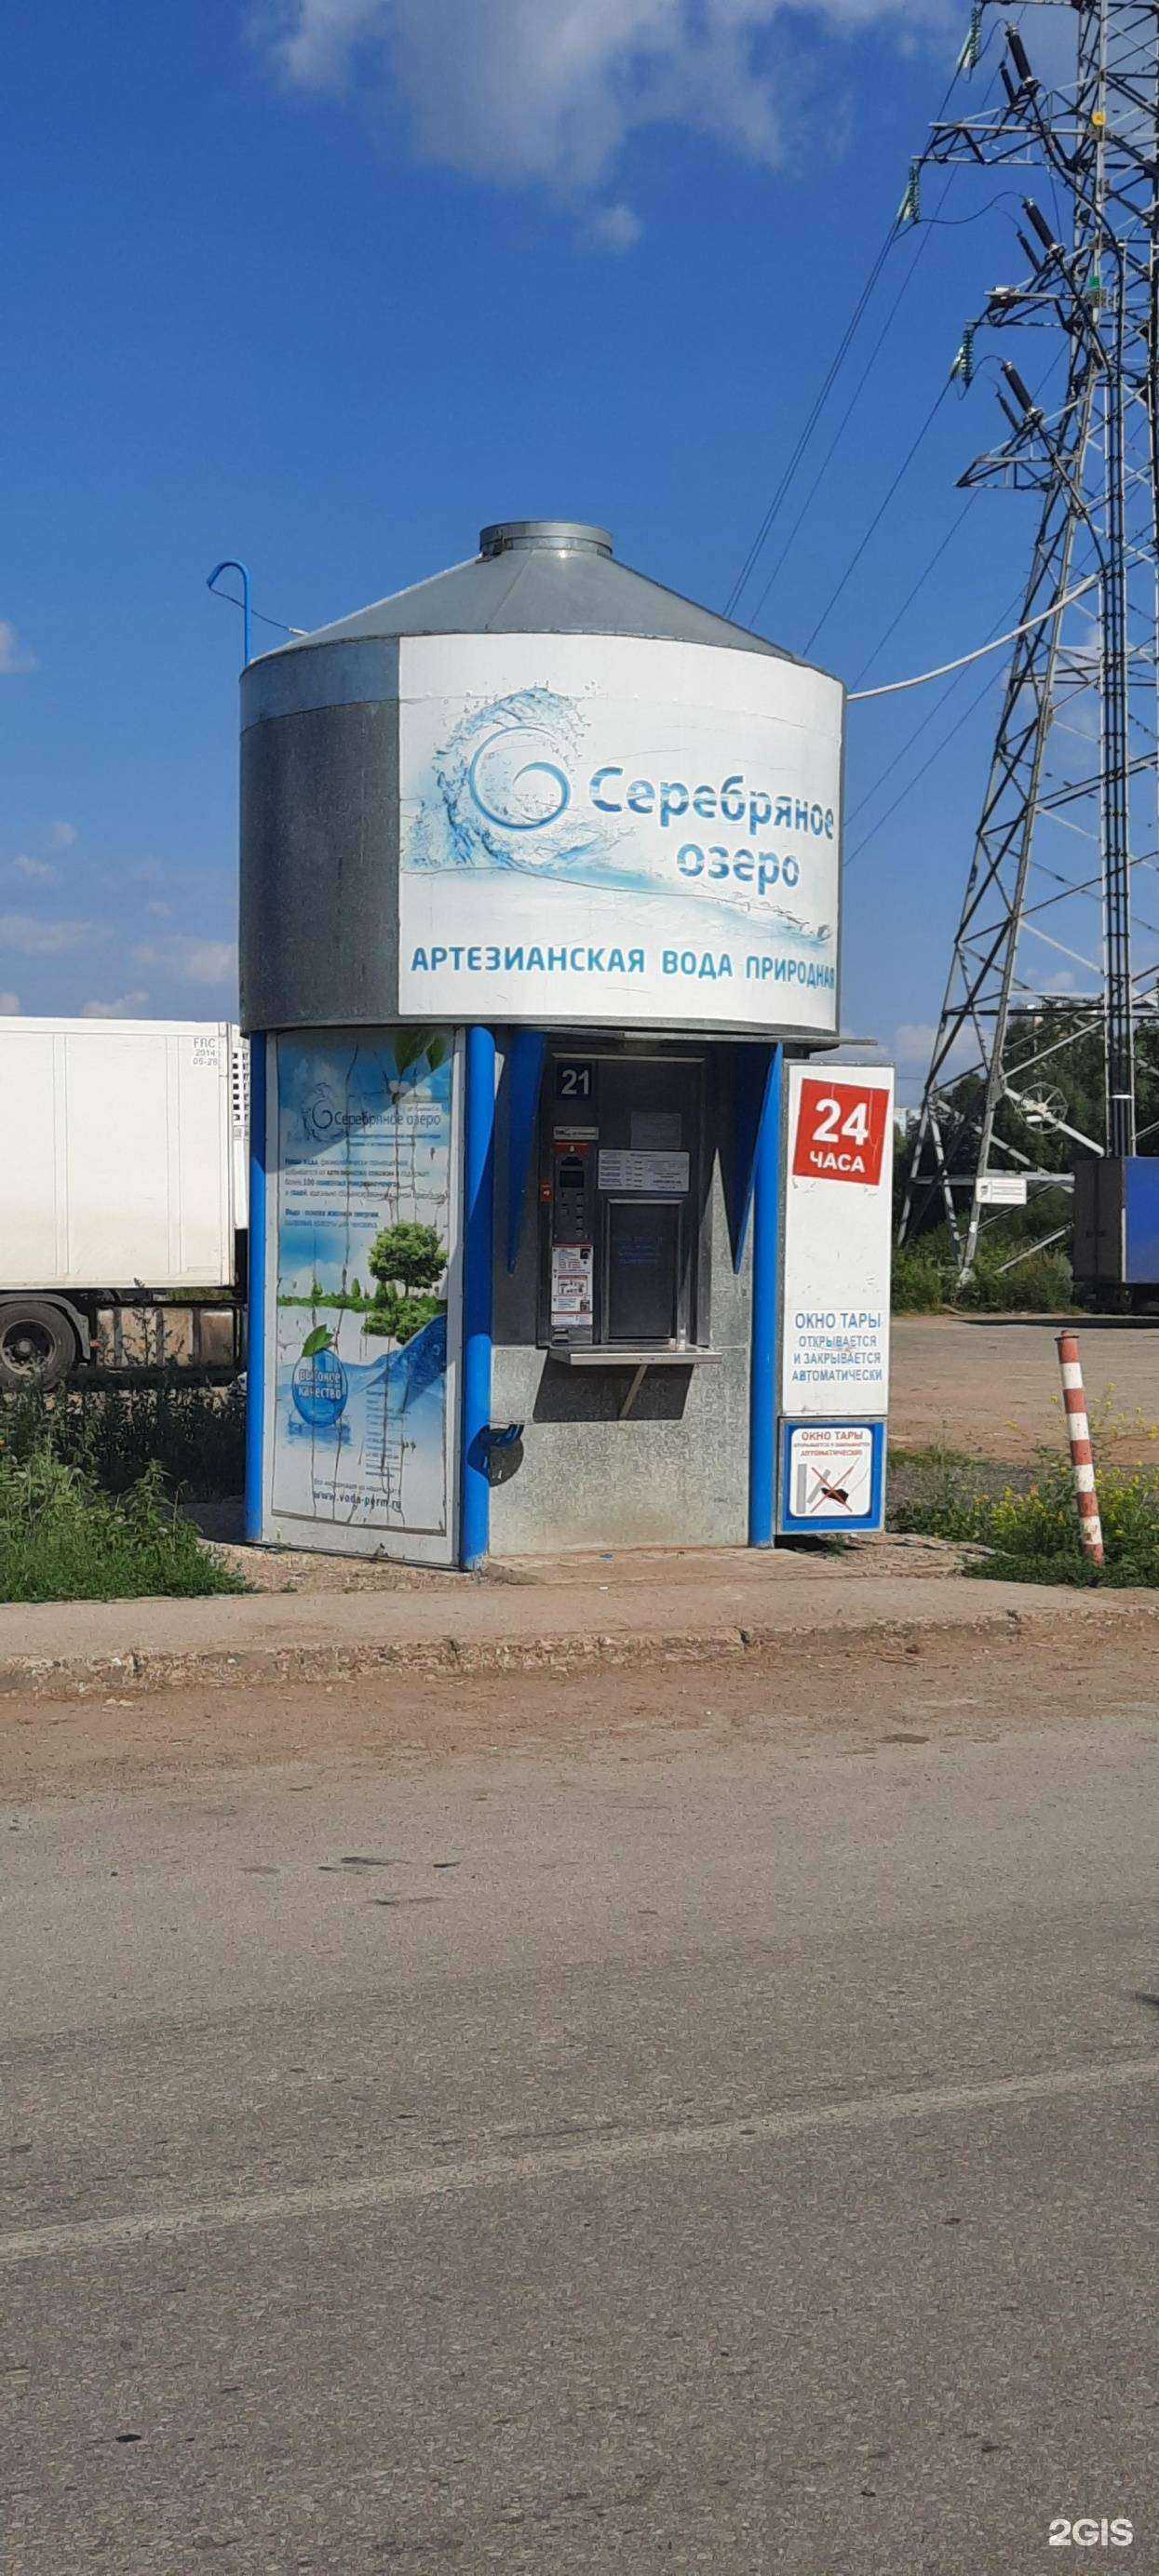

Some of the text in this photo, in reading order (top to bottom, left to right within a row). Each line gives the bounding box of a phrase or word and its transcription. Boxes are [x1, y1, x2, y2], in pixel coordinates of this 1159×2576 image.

[589, 766, 834, 839] Серебряное
[677, 843, 800, 895] озеро
[411, 946, 835, 989] АРТЕЗИАНСКАЯ ВОДА ПРИРОДНАЯ
[560, 1069, 589, 1095] 21
[334, 1110, 404, 1127] Серебряное
[812, 1098, 869, 1146] 24
[809, 1150, 866, 1173] ЧАСА
[795, 1312, 881, 1329] ОКНО ТАРЫ
[799, 1335, 877, 1348] ОТКРЫВАЕТСЯ
[793, 1352, 881, 1365] И ЗАКРЫВАЕТСЯ
[792, 1369, 883, 1381] АВТОМАТИЧЕСКИ
[801, 1430, 863, 1441] ОКНО ТАРЫ
